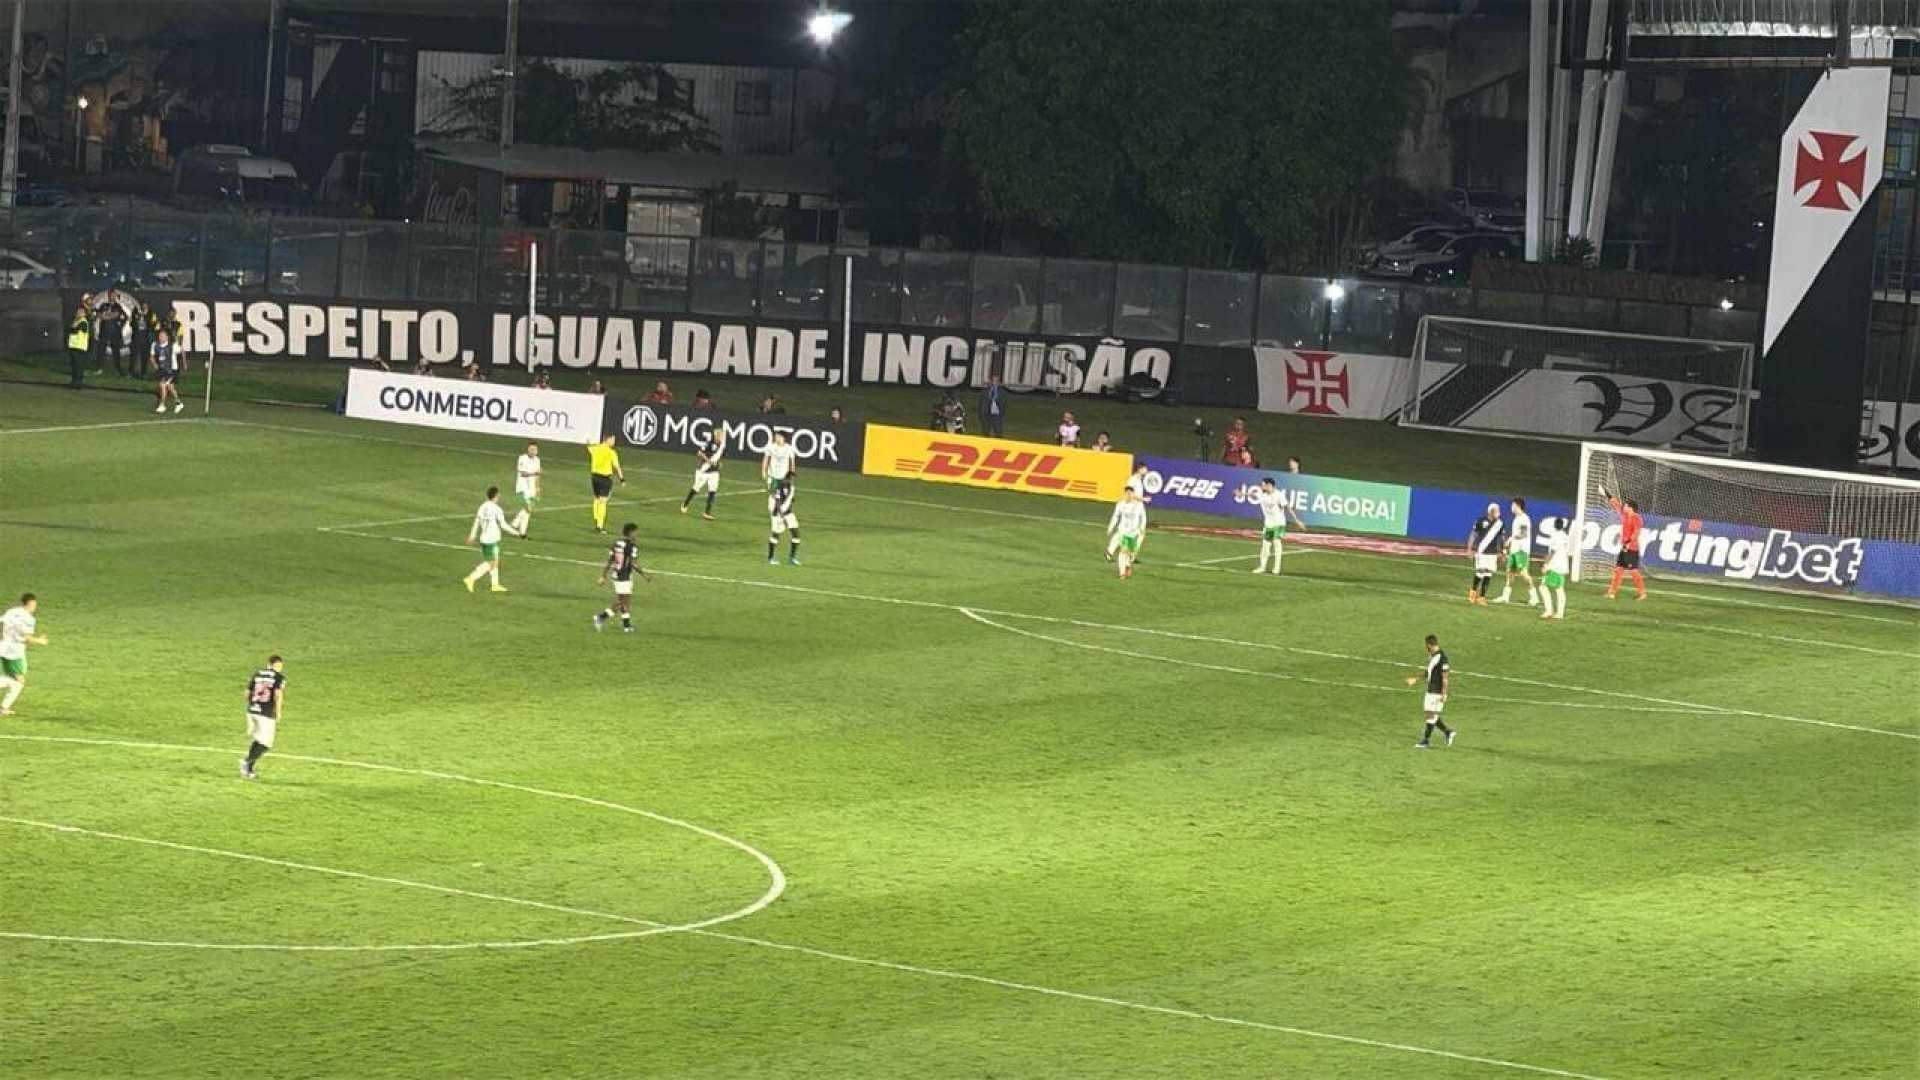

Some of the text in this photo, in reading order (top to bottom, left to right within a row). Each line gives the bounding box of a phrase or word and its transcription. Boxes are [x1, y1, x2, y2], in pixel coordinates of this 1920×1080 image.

[171, 300, 1171, 398] RESPEITO, IGUALDADE, INCLUSÃO
[663, 413, 838, 462] MG MOTOR
[923, 441, 1070, 490] DHL
[1233, 483, 1396, 521] JOUE AGORA!
